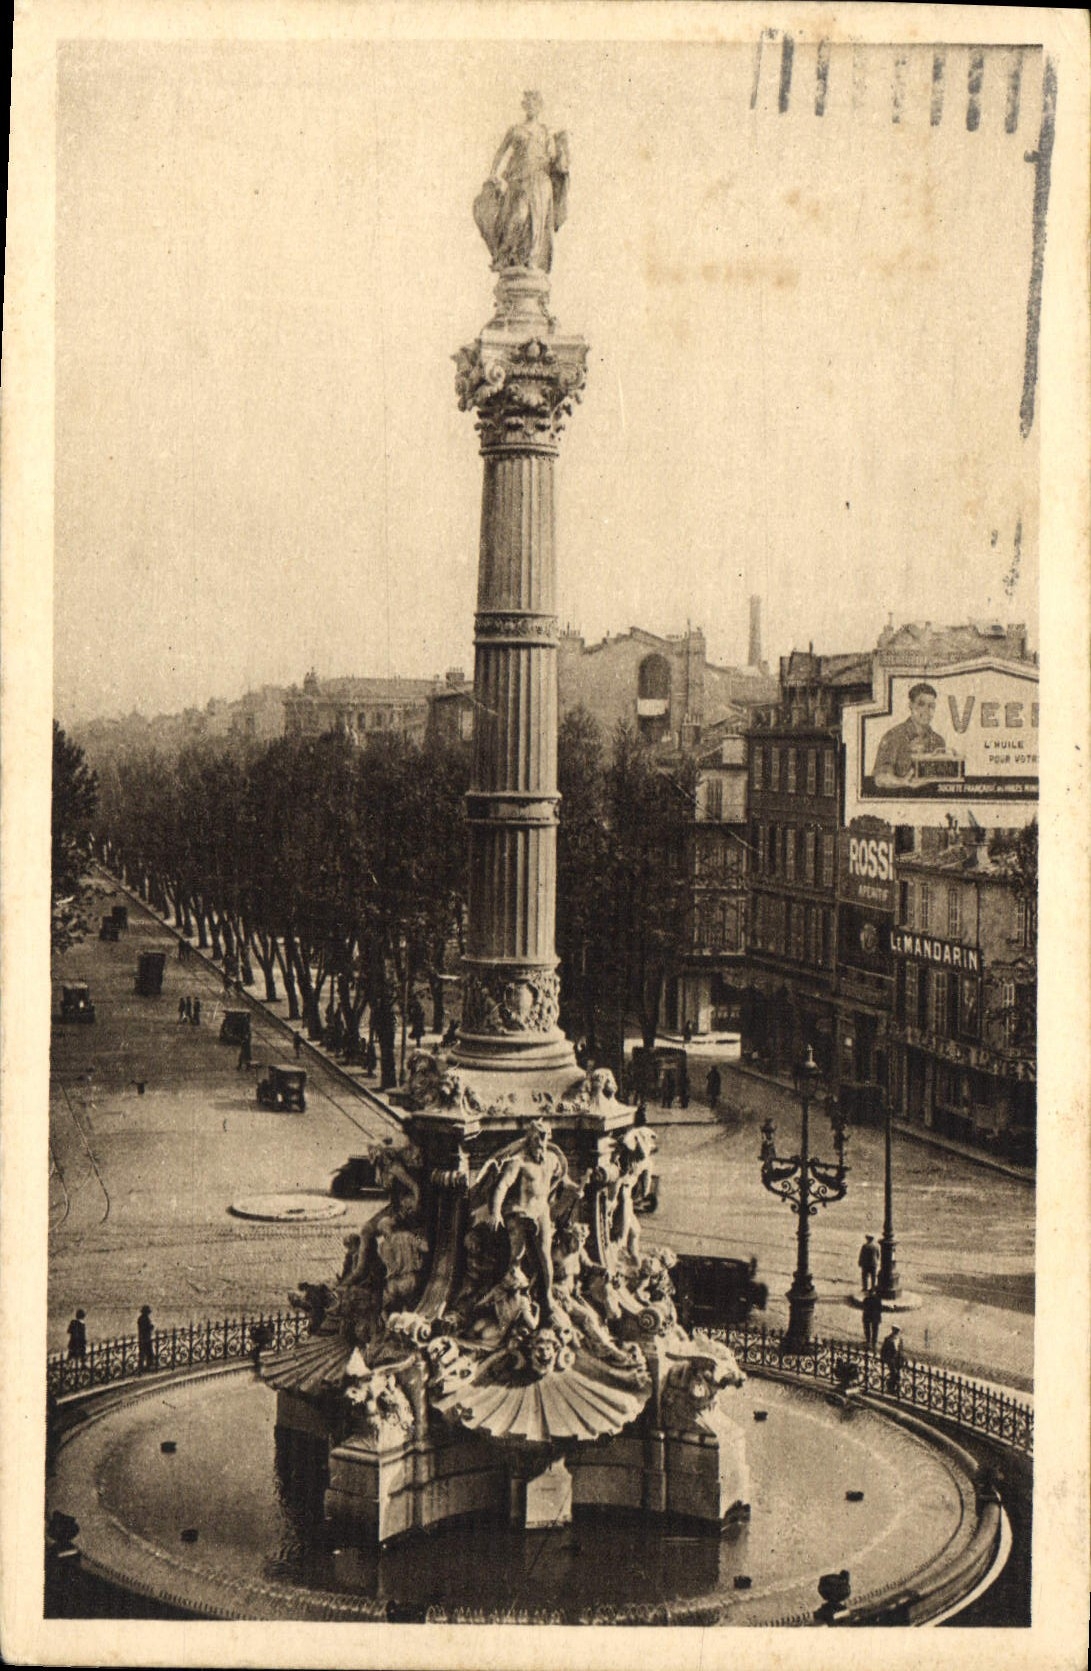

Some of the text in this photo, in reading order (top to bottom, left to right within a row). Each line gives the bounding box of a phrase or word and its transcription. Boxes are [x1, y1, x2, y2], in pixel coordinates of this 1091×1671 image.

[984, 740, 1024, 749] L'HUILE
[989, 754, 1011, 764] POUR
[849, 837, 894, 881] ROSSI
[903, 934, 978, 971] MANDARIN
